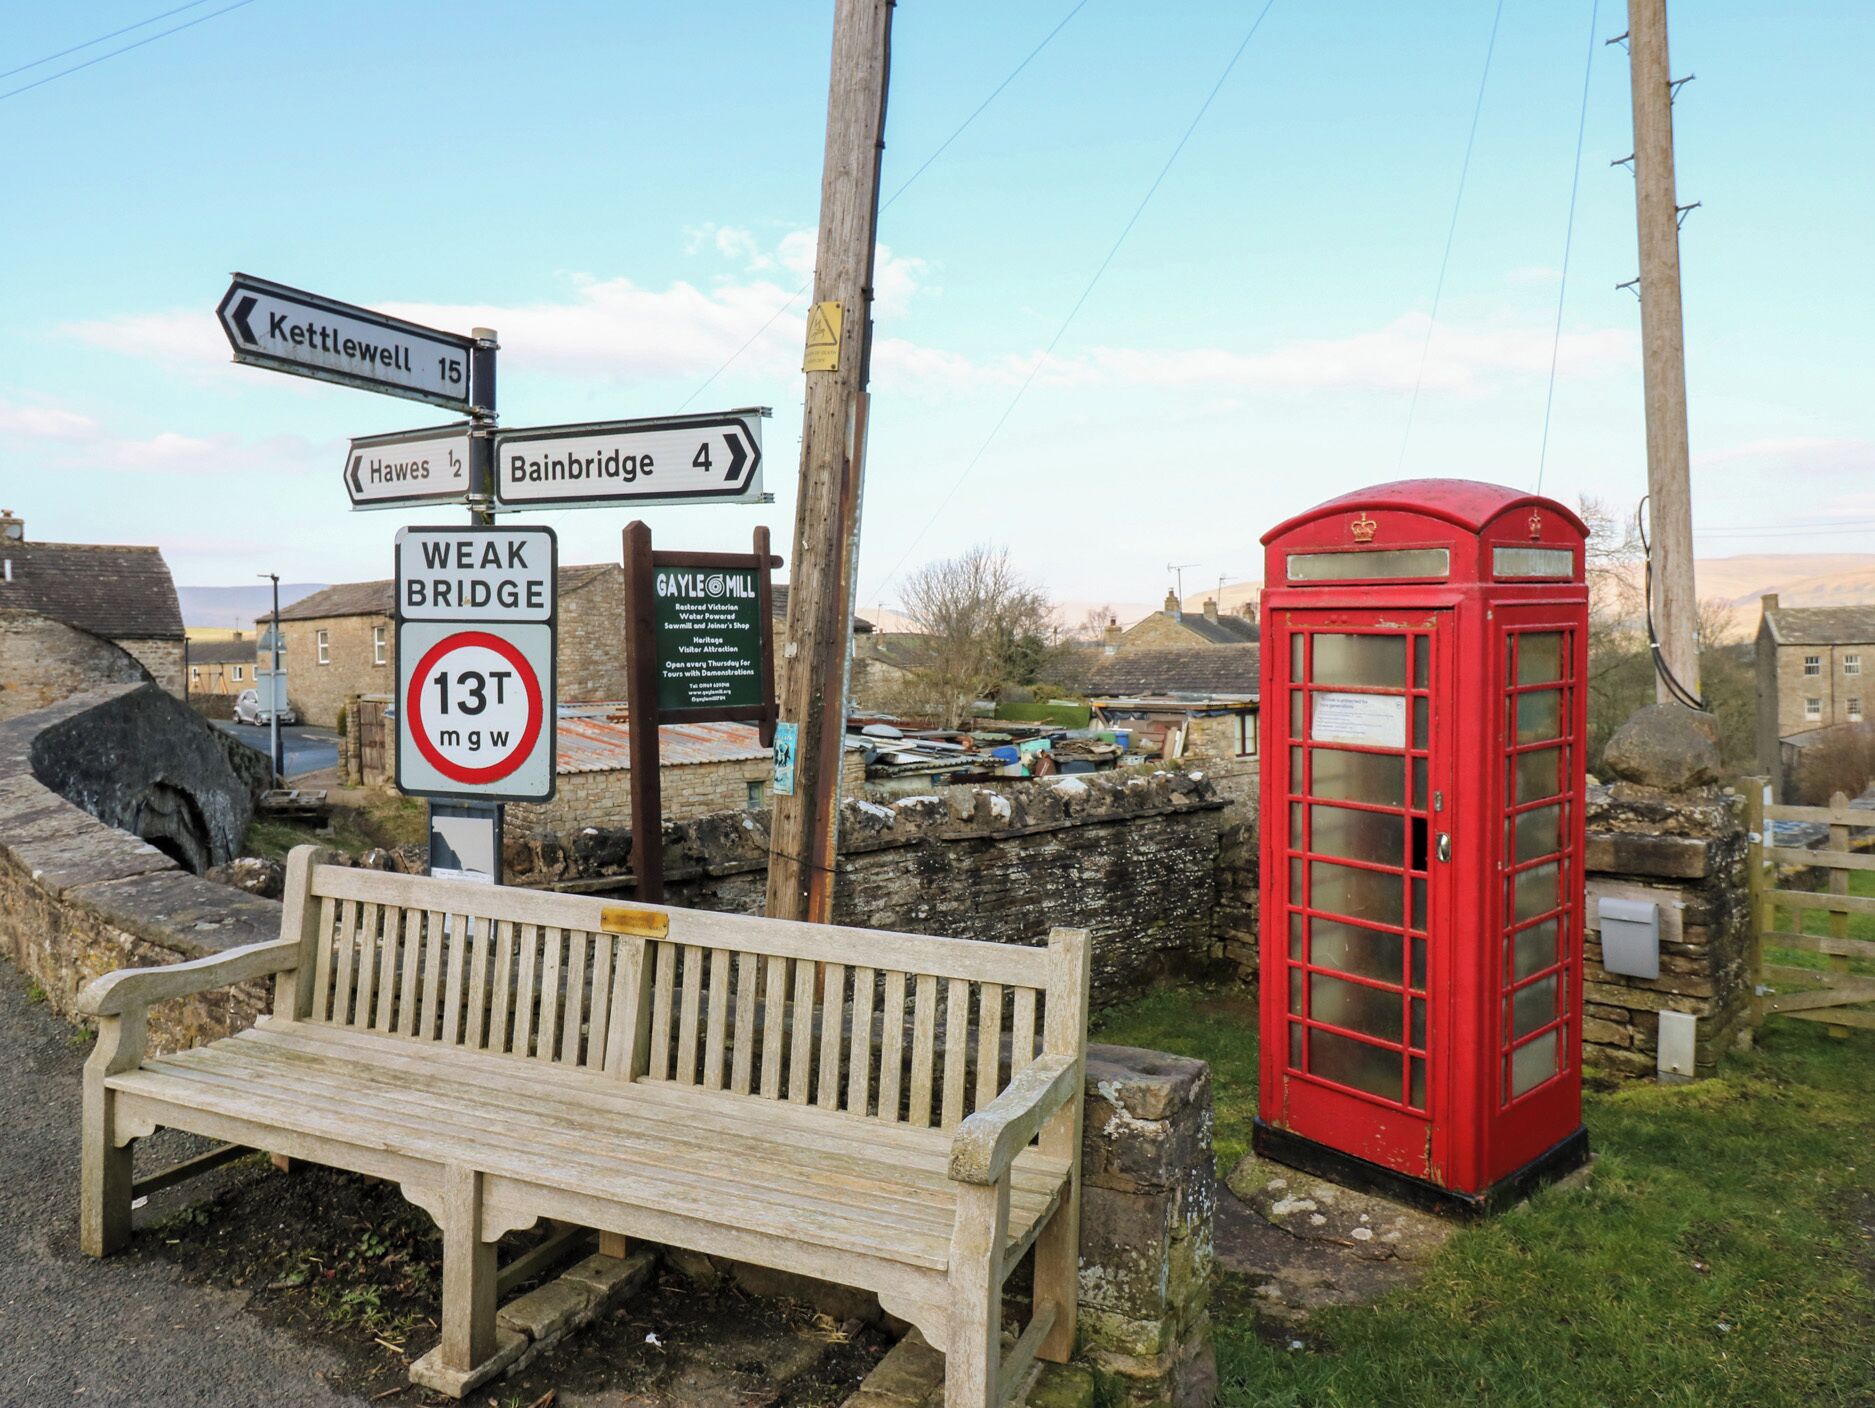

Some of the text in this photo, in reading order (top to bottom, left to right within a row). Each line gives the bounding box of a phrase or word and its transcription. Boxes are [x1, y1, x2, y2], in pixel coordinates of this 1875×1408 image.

[268, 311, 462, 384] Kettlewell 15
[511, 442, 713, 483] Bainbridge 4
[370, 458, 430, 484] Hawes
[421, 540, 529, 569] WEAK
[656, 573, 756, 598] GAYLE MILL
[407, 579, 545, 609] BRIDGE
[675, 603, 739, 611] Restored Victorian
[679, 612, 736, 620] Water Powered
[664, 622, 692, 630] Sawmill
[706, 622, 732, 630] Joiner's
[733, 622, 750, 631] Shop
[693, 636, 724, 645] Heritage
[678, 645, 739, 654] Visitor Attraction
[665, 659, 751, 670] Open every Thursday for
[662, 668, 755, 678] Tours with Demonstrations
